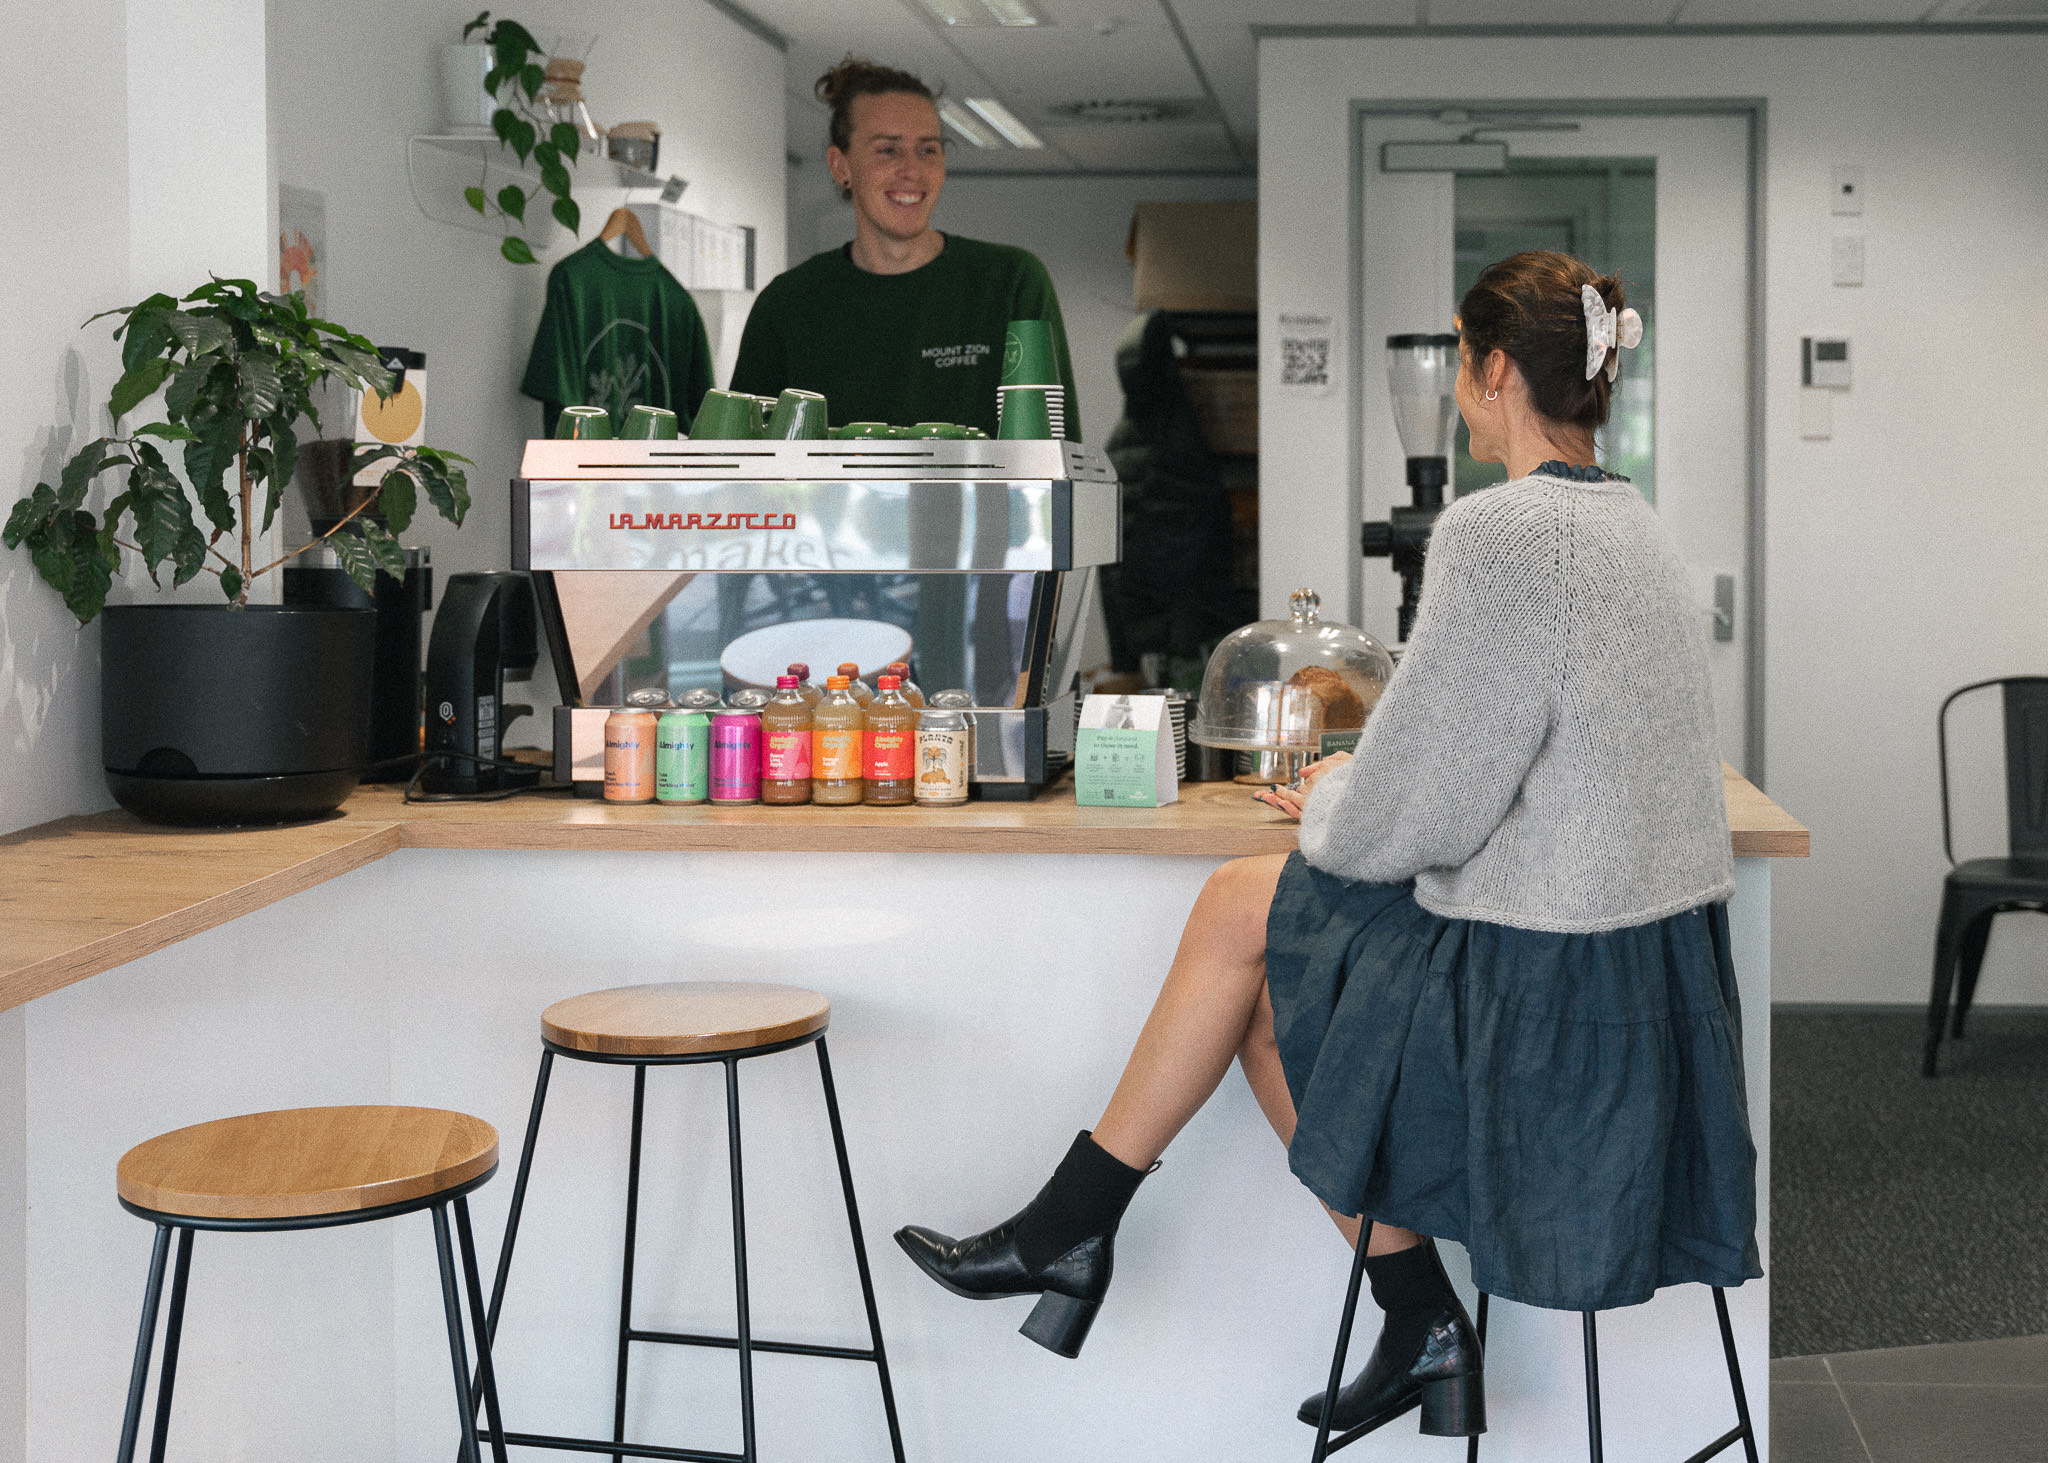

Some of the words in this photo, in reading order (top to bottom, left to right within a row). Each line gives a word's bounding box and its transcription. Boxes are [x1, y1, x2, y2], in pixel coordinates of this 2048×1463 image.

[921, 345, 963, 358] MOUNT
[964, 343, 990, 355] ZION
[934, 354, 978, 368] COFFEE
[770, 736, 798, 744] Almighty
[822, 735, 851, 744] Almighty
[875, 735, 903, 744] Almighty
[919, 733, 953, 745] PLANTA
[605, 741, 640, 750] Almighty
[658, 741, 695, 751] Almighty
[714, 741, 752, 750] Almighty
[770, 742, 794, 750] Organic
[874, 742, 899, 750] Organic
[1326, 740, 1355, 748] BANANA
